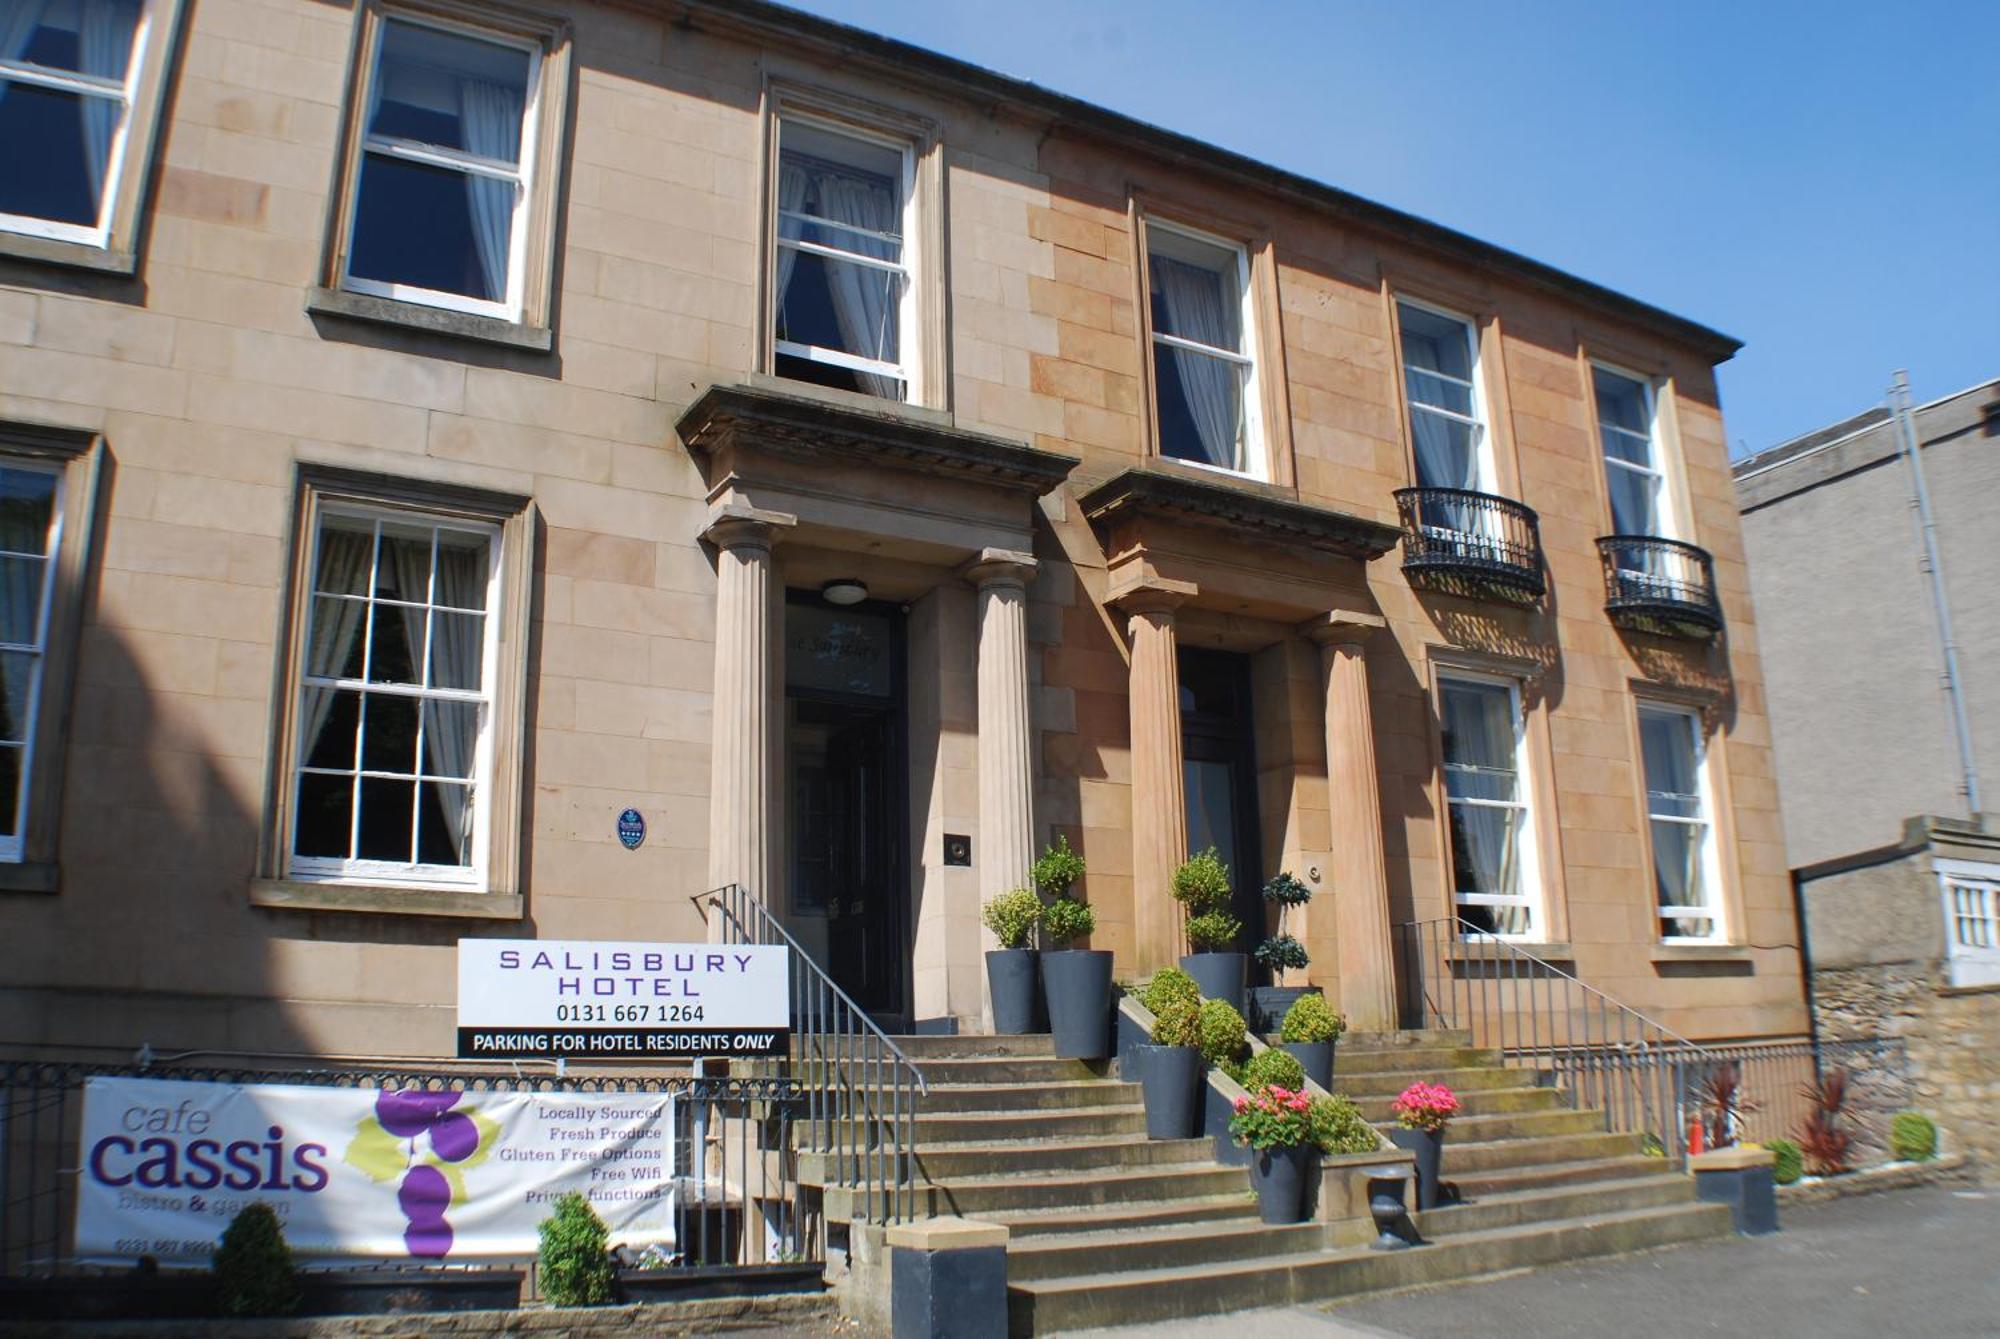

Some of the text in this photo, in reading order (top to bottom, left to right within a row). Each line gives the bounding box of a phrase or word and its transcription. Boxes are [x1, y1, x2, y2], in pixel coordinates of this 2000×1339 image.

[500, 950, 753, 972] SALISBURY
[559, 977, 700, 997] HOTEL
[557, 1004, 705, 1022] 0131 667 1264
[473, 1035, 775, 1050] PARKING FOR HOTEL RESIDENTS ONLY
[122, 1100, 211, 1134] cafe
[539, 1107, 662, 1122] Locally Sourced
[549, 1127, 661, 1140] Fresh Produce
[89, 1125, 329, 1192] cassis
[500, 1148, 661, 1163] Gluten Free Options
[592, 1167, 661, 1180] Free Wifi
[587, 1187, 661, 1201] functions
[189, 1194, 206, 1213] &
